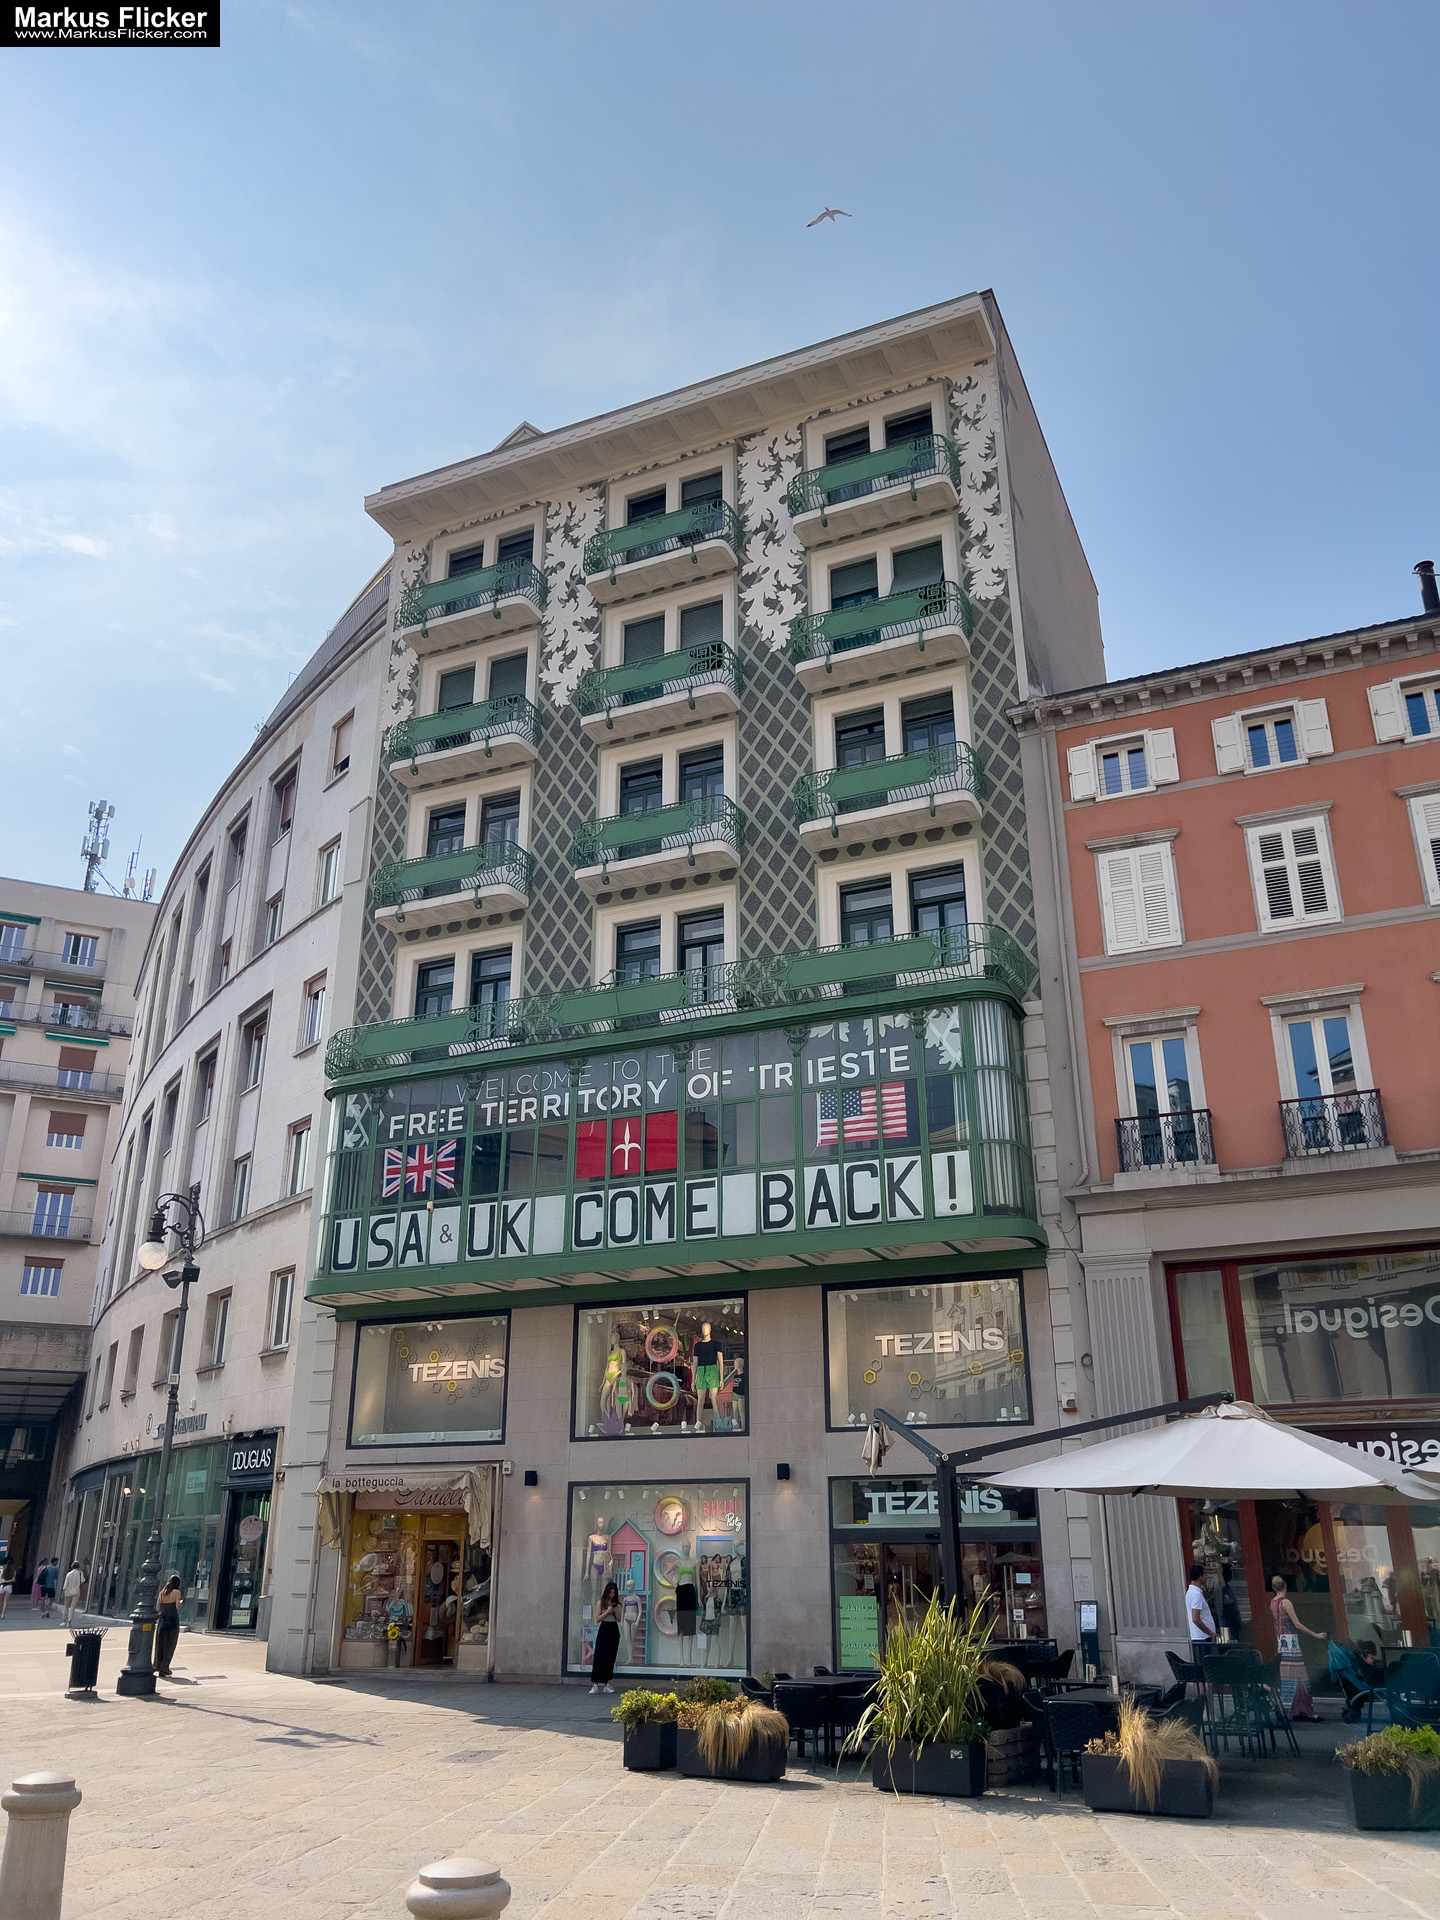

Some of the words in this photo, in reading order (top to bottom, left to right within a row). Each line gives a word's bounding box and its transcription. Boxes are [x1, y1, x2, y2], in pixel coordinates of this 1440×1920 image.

[456, 1064, 592, 1102] WELCOME
[604, 1058, 640, 1081] TO
[656, 1049, 712, 1075] THE
[389, 1106, 464, 1139] FREE
[481, 1078, 667, 1127] TERRITORY
[687, 1069, 733, 1100] OF
[749, 1045, 910, 1090] TRIESTE
[332, 1213, 424, 1271] USA
[439, 1223, 453, 1243] &
[467, 1202, 527, 1257] UK
[574, 1181, 717, 1248] COME
[762, 1154, 958, 1230] BACK!
[874, 1324, 1005, 1357] TEZENIS
[409, 1354, 505, 1382] TEZENIS
[232, 1448, 271, 1471] DOUGLAS
[332, 1478, 340, 1488] la
[345, 1476, 404, 1489] botteguccia
[864, 1485, 1004, 1515] TEZENIS
[707, 1579, 746, 1588] TEZENIS
[843, 1641, 868, 1649] PIANO
